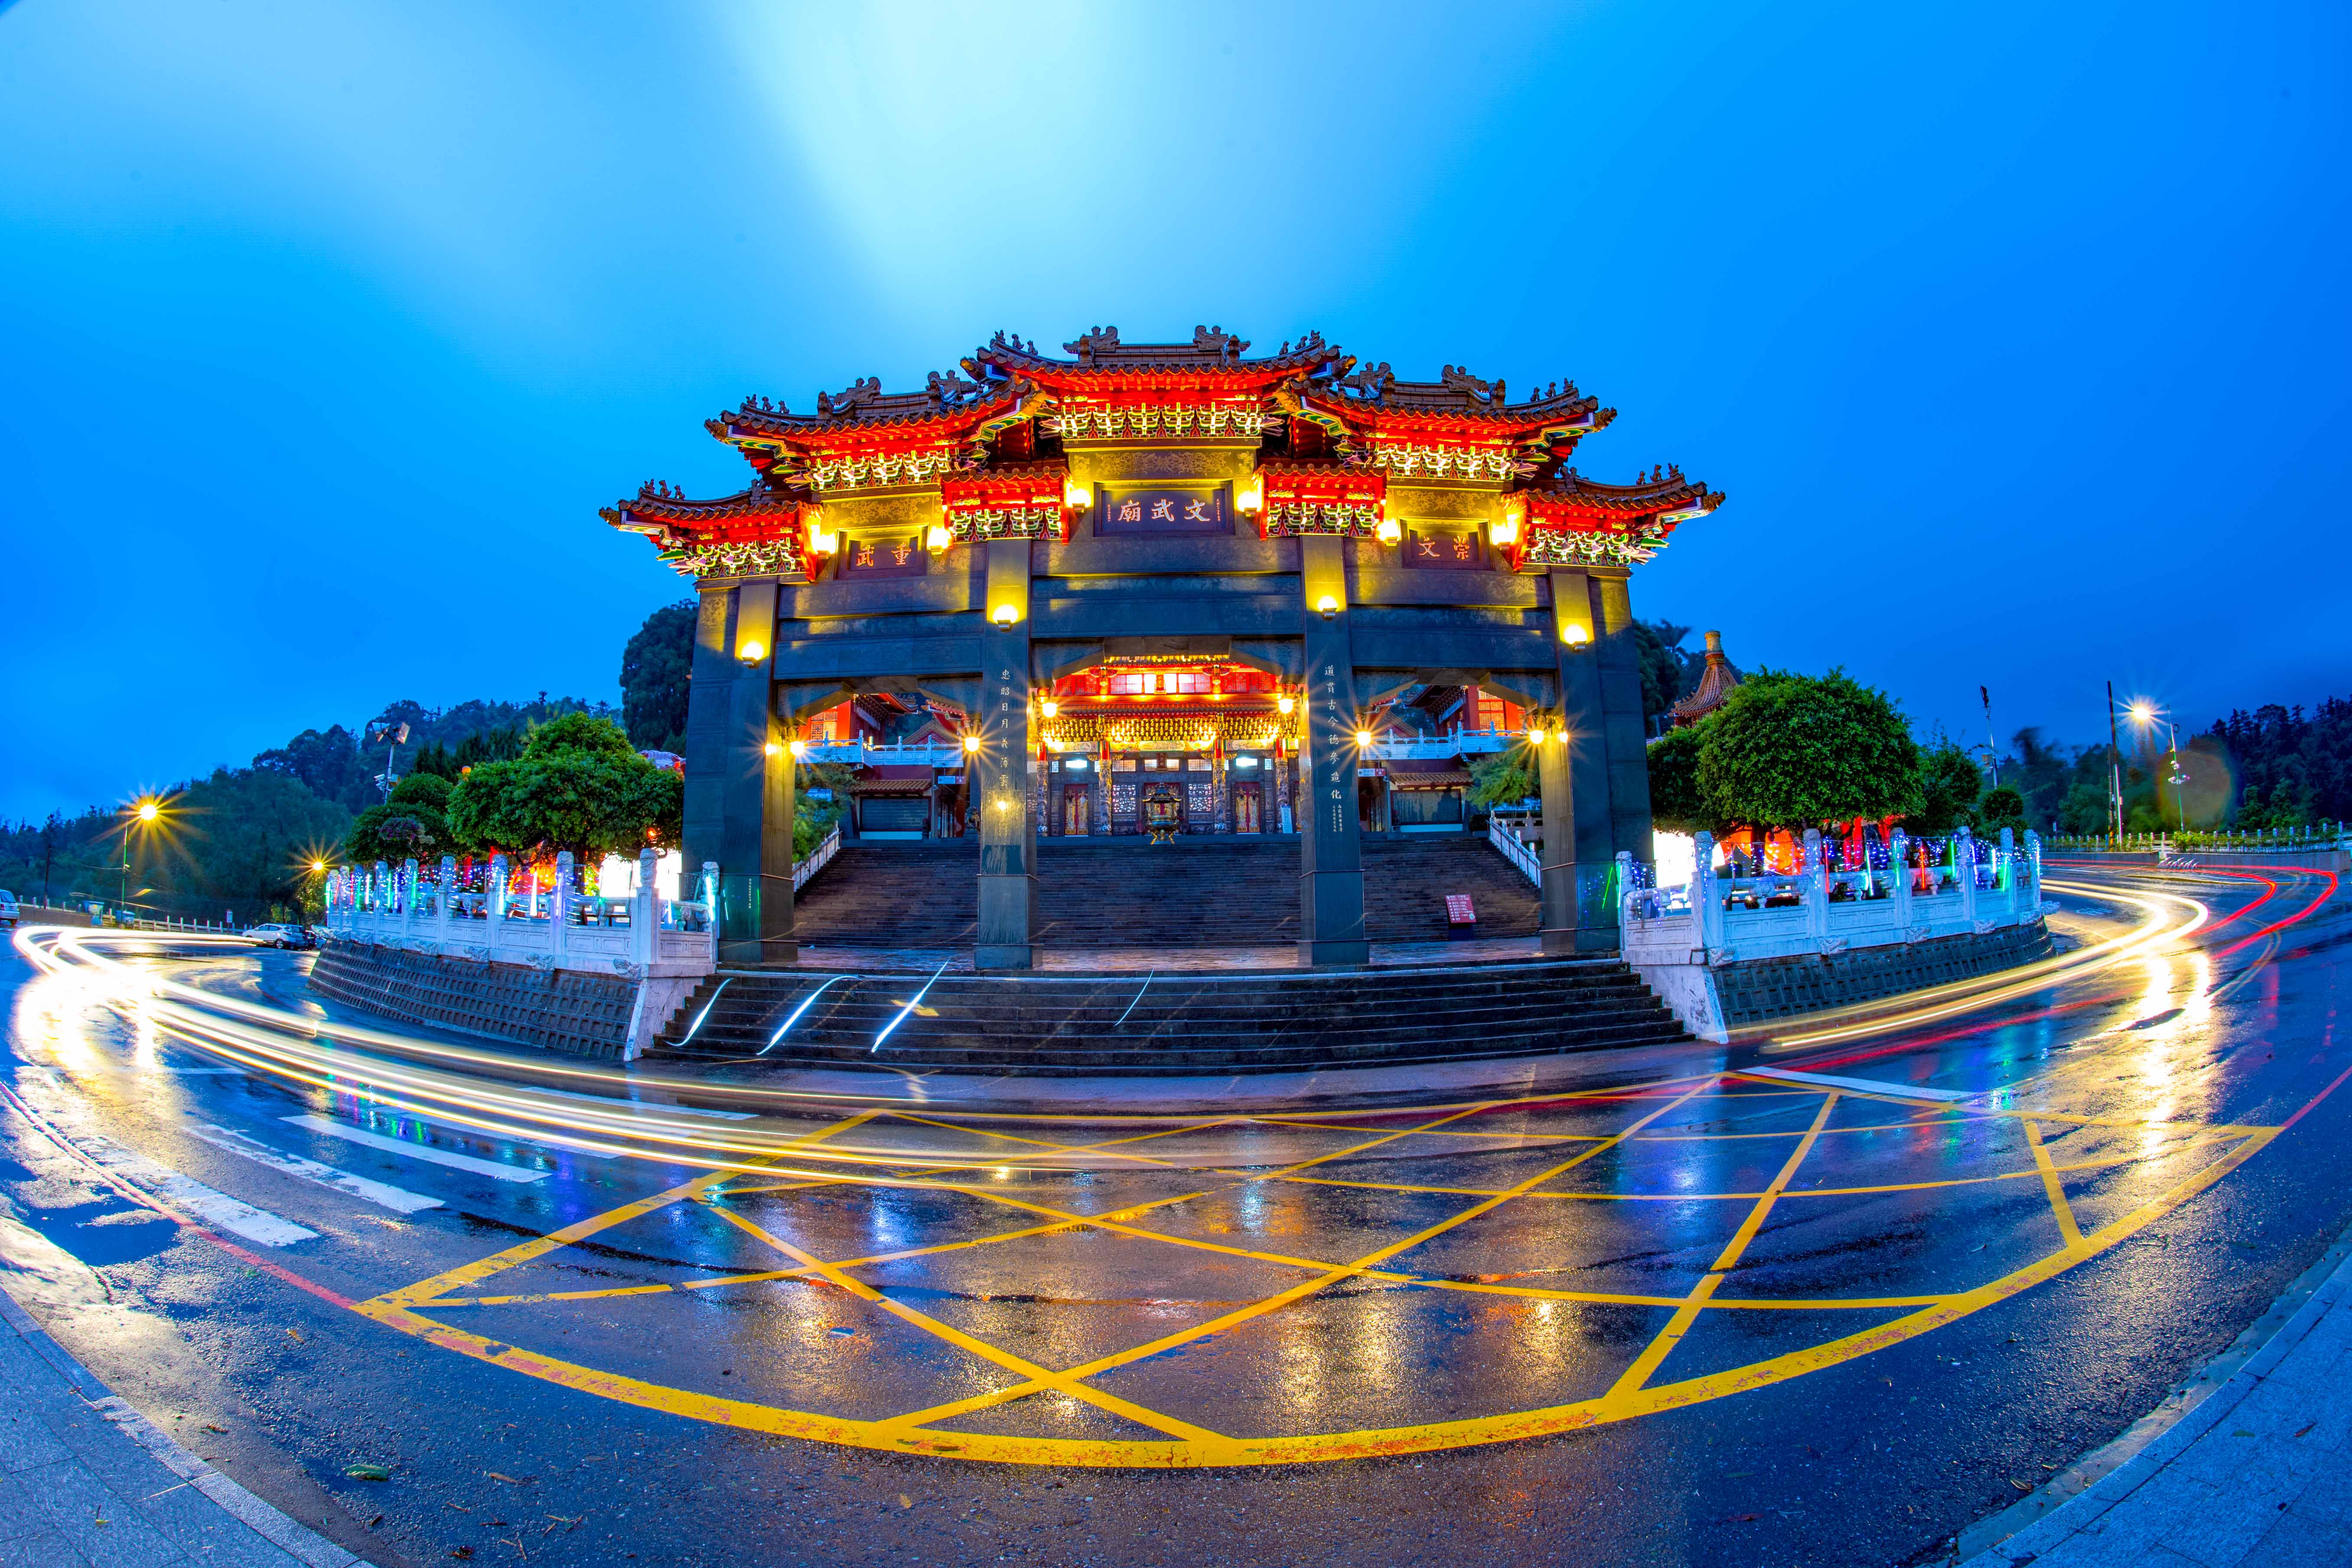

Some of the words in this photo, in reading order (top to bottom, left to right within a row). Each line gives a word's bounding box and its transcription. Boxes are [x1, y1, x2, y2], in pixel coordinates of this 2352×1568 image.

[1118, 498, 1210, 522] 文武廟
[856, 542, 911, 567] 重武
[1418, 536, 1470, 560] 崇文
[999, 669, 1011, 810] 忠昭日月義薄雲
